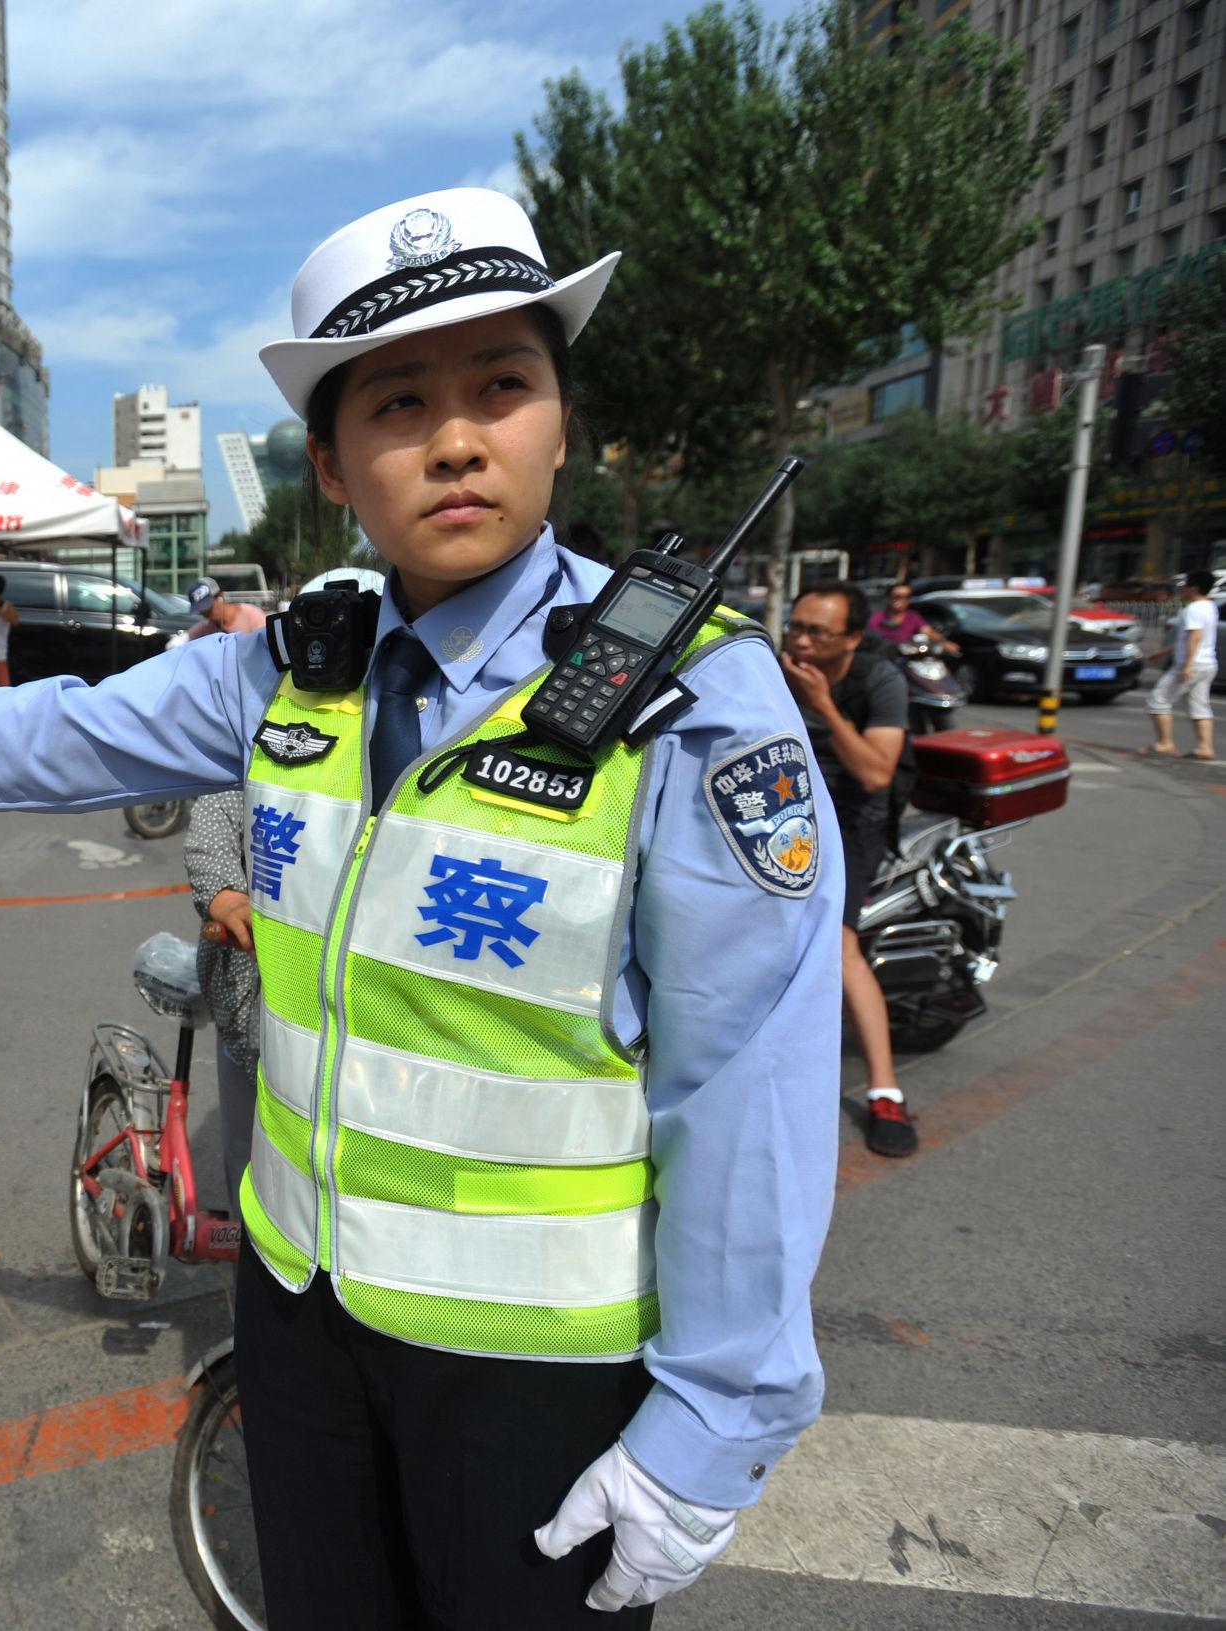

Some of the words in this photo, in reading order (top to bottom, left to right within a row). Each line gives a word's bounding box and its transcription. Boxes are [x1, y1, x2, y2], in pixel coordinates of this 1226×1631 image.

[475, 754, 585, 800] 102853
[714, 743, 807, 796] 中华人民共和国
[732, 791, 768, 820] 警
[771, 803, 806, 826] POLICE
[249, 804, 306, 902] 警
[414, 854, 549, 969] 察
